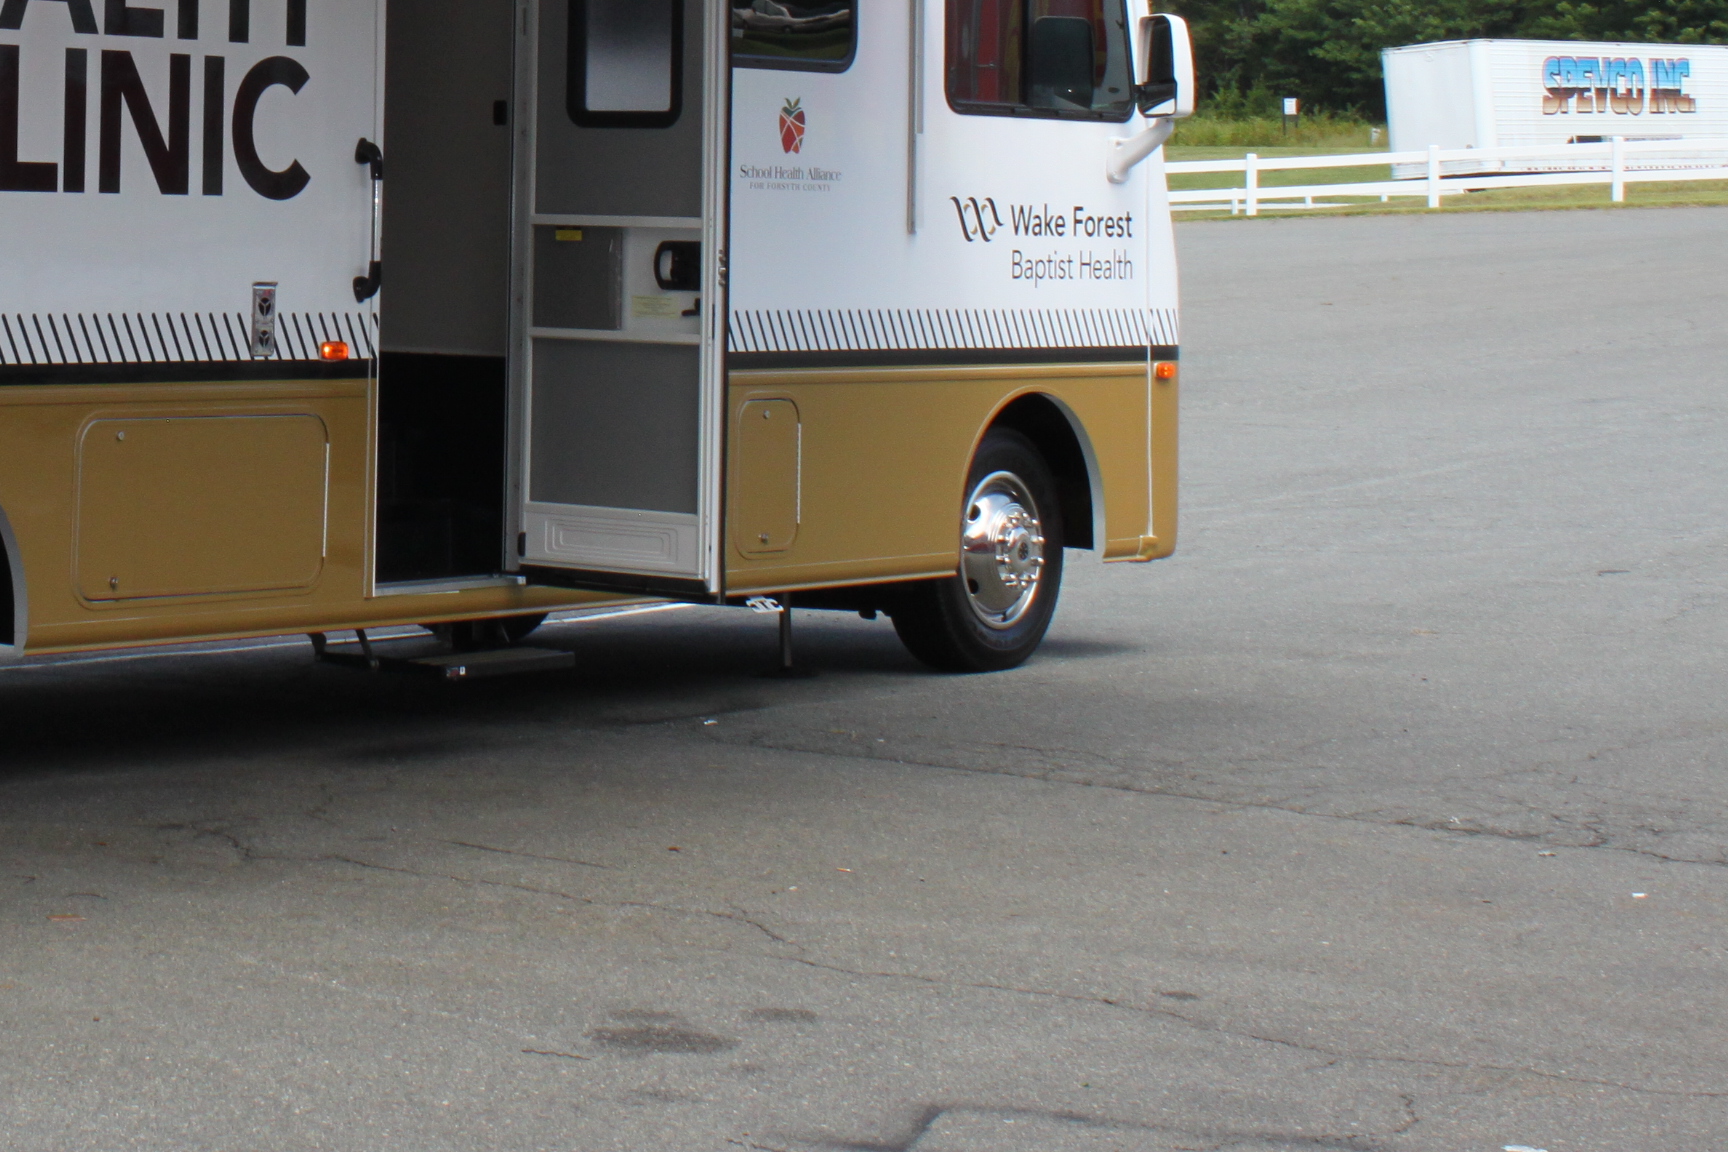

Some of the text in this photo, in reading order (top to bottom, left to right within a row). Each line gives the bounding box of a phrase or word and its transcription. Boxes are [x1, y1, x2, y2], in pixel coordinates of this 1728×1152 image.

[1542, 55, 1697, 116] SPEVCO INC.
[740, 164, 841, 181] School Health Alliance
[749, 181, 765, 190] FOR
[802, 183, 831, 192] COUNTY
[1010, 203, 1133, 238] Wake Forest
[1011, 249, 1133, 288] Baptist Health
